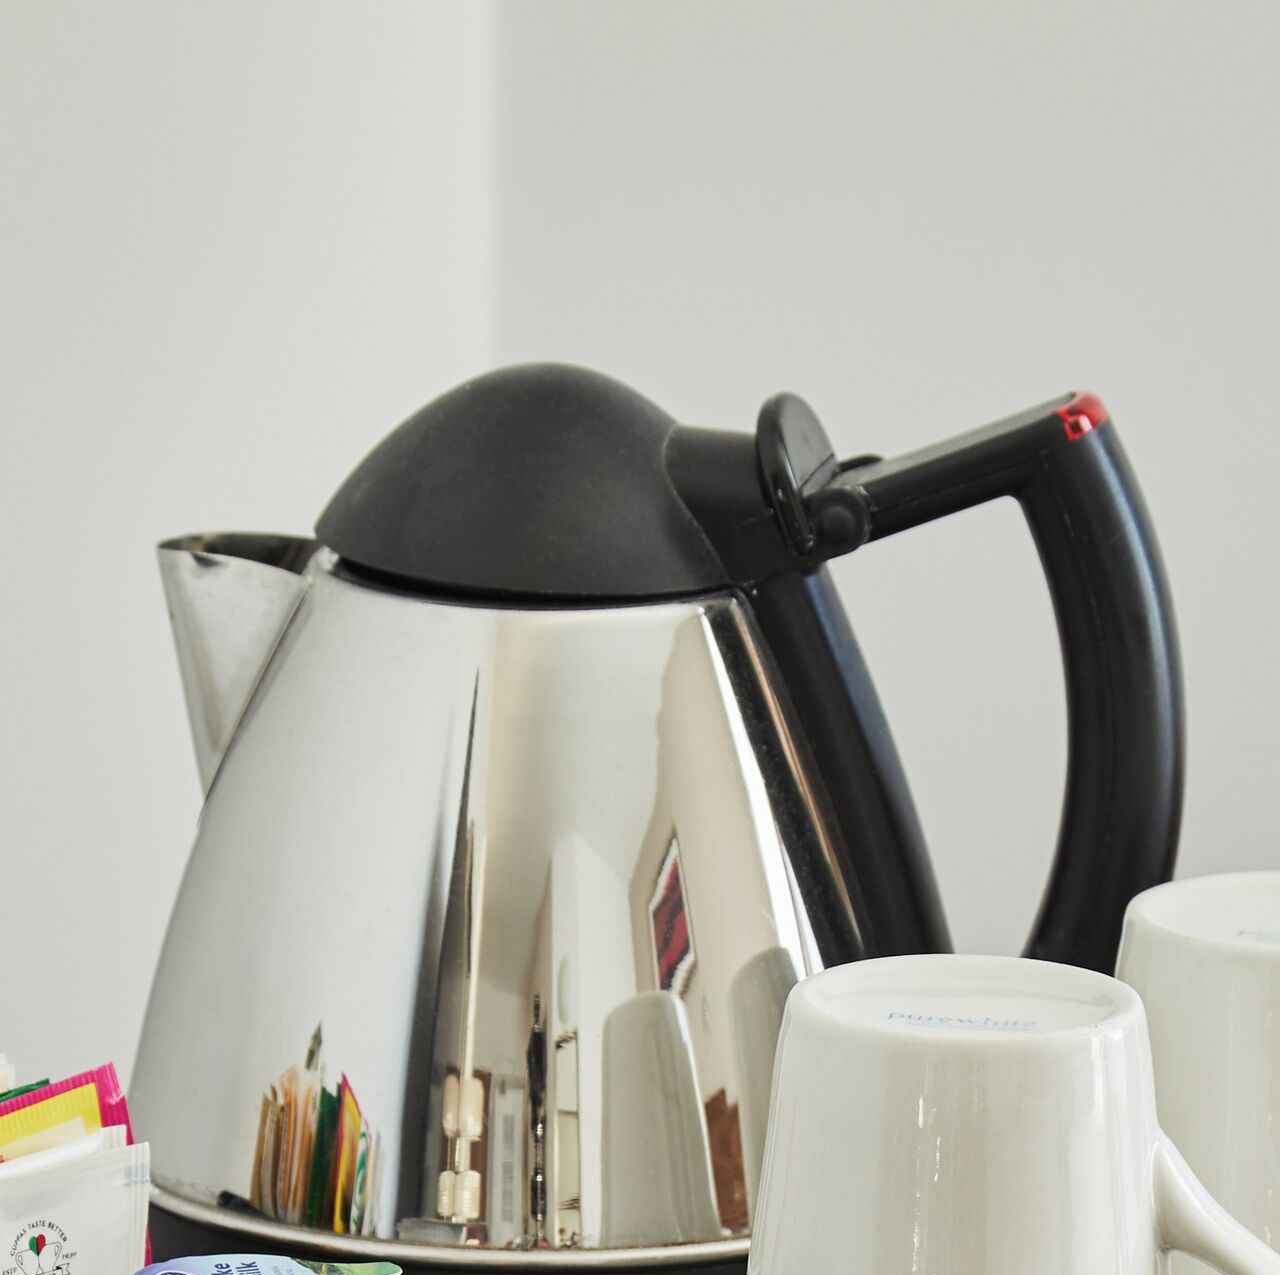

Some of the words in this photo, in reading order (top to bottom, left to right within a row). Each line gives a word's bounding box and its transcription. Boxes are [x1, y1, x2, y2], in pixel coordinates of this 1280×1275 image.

[10, 1228, 27, 1257] CUPPAS
[28, 1220, 45, 1230] TASTE
[47, 1221, 67, 1242] BETTER
